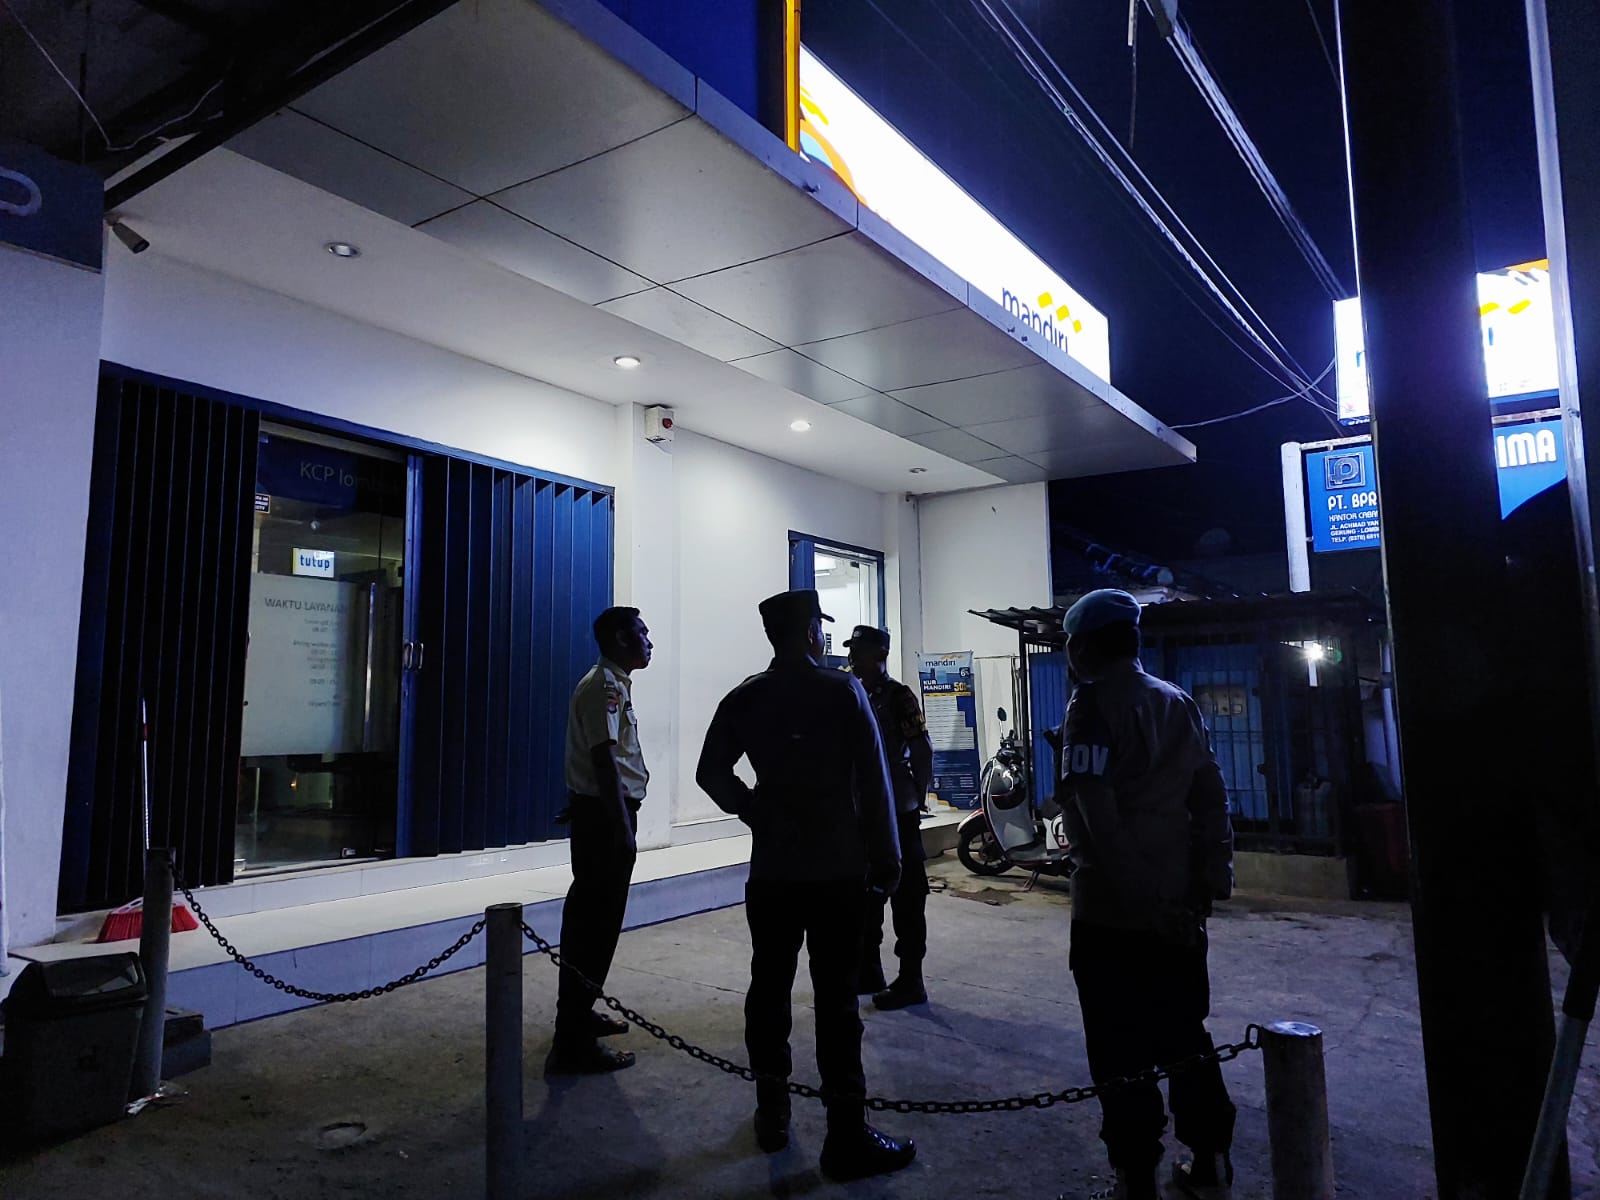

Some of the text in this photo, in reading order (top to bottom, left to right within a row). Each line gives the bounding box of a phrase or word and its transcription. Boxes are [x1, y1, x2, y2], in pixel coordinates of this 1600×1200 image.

[1002, 287, 1068, 354] mandiri
[1496, 429, 1557, 468] IMA
[300, 461, 335, 482] KCP
[1327, 491, 1378, 511] PT. BPR
[1328, 513, 1358, 522] KANTOR
[299, 554, 331, 571] tutup
[264, 597, 302, 611] WAKTU
[925, 659, 956, 667] mandiri
[1062, 744, 1109, 776] OV
